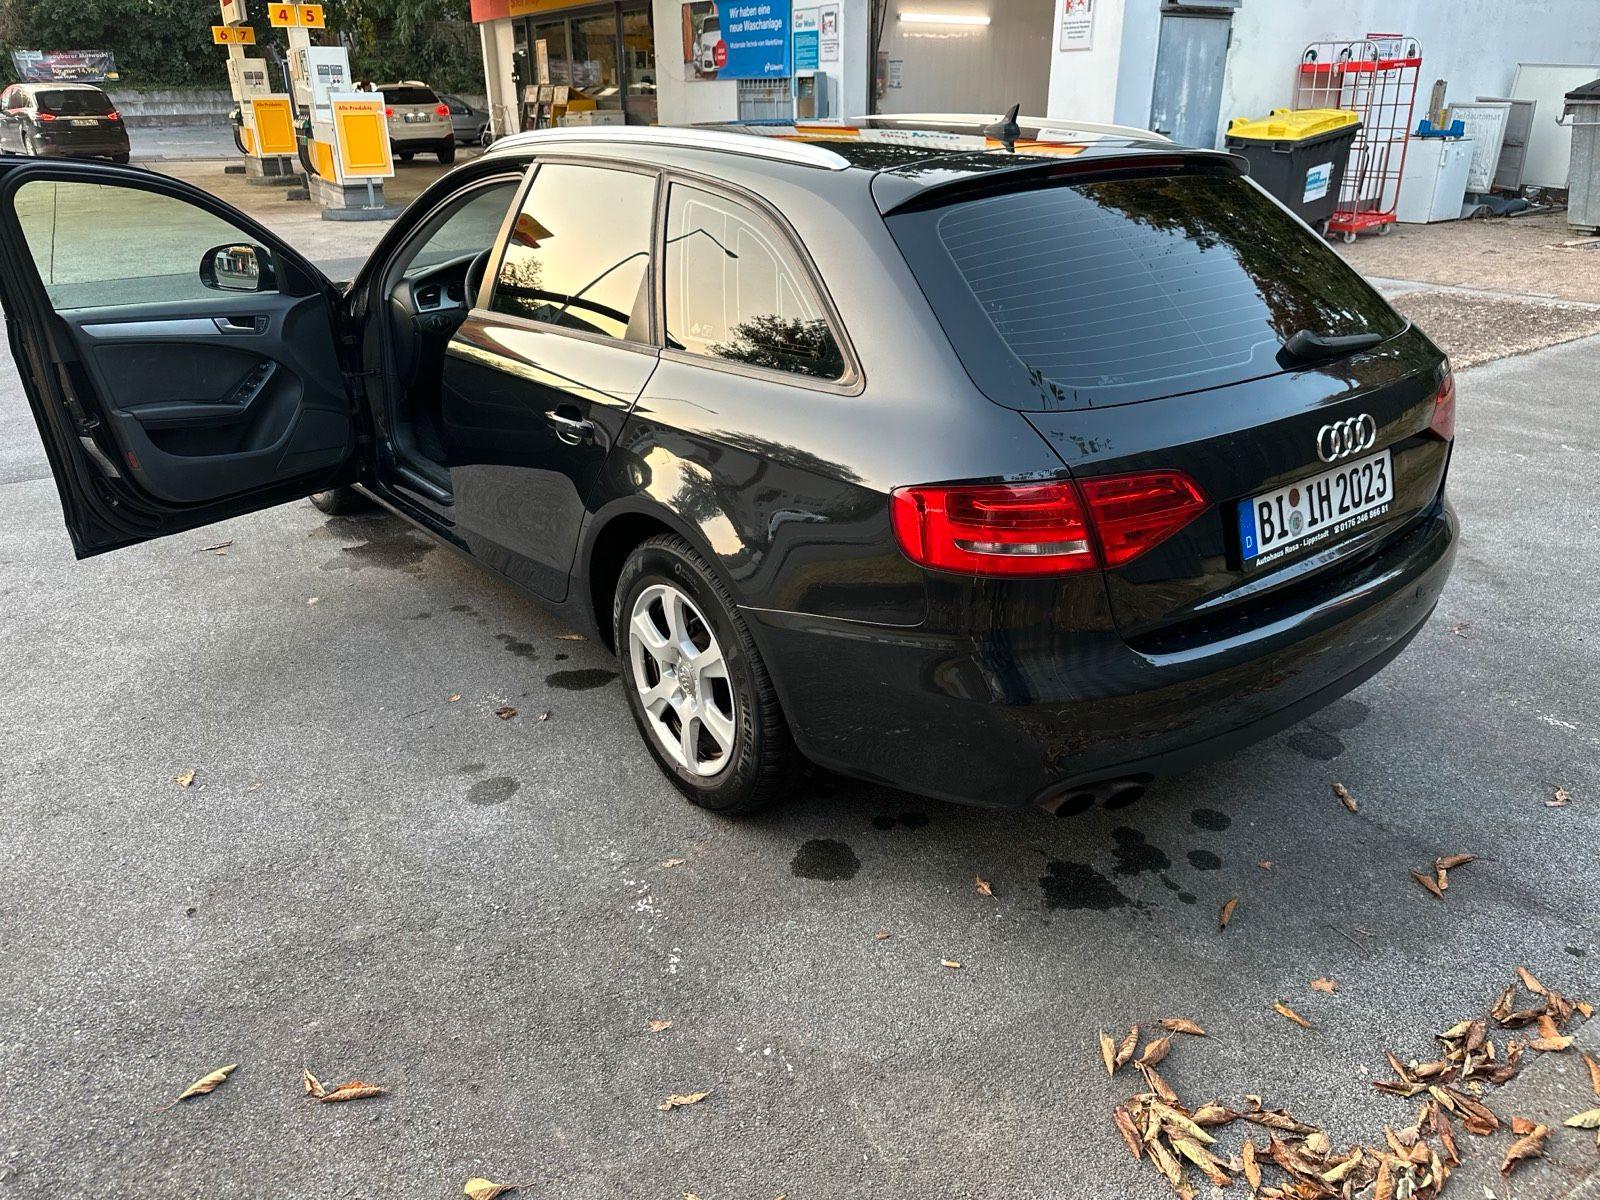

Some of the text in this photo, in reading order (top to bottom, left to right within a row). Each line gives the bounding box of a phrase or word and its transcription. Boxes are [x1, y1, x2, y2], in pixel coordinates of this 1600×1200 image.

[279, 9, 315, 22] 4 5
[730, 4, 771, 18] Wir haben eine
[730, 18, 783, 32] neue Waschanlage
[220, 30, 247, 40] 6 7
[1258, 495, 1289, 545] BI
[1336, 457, 1387, 514] 2023
[1246, 536, 1253, 549] D
[1256, 550, 1284, 566] Autohaus
[1284, 543, 1299, 555] Rosa
[1303, 530, 1329, 546] Lippstadt
